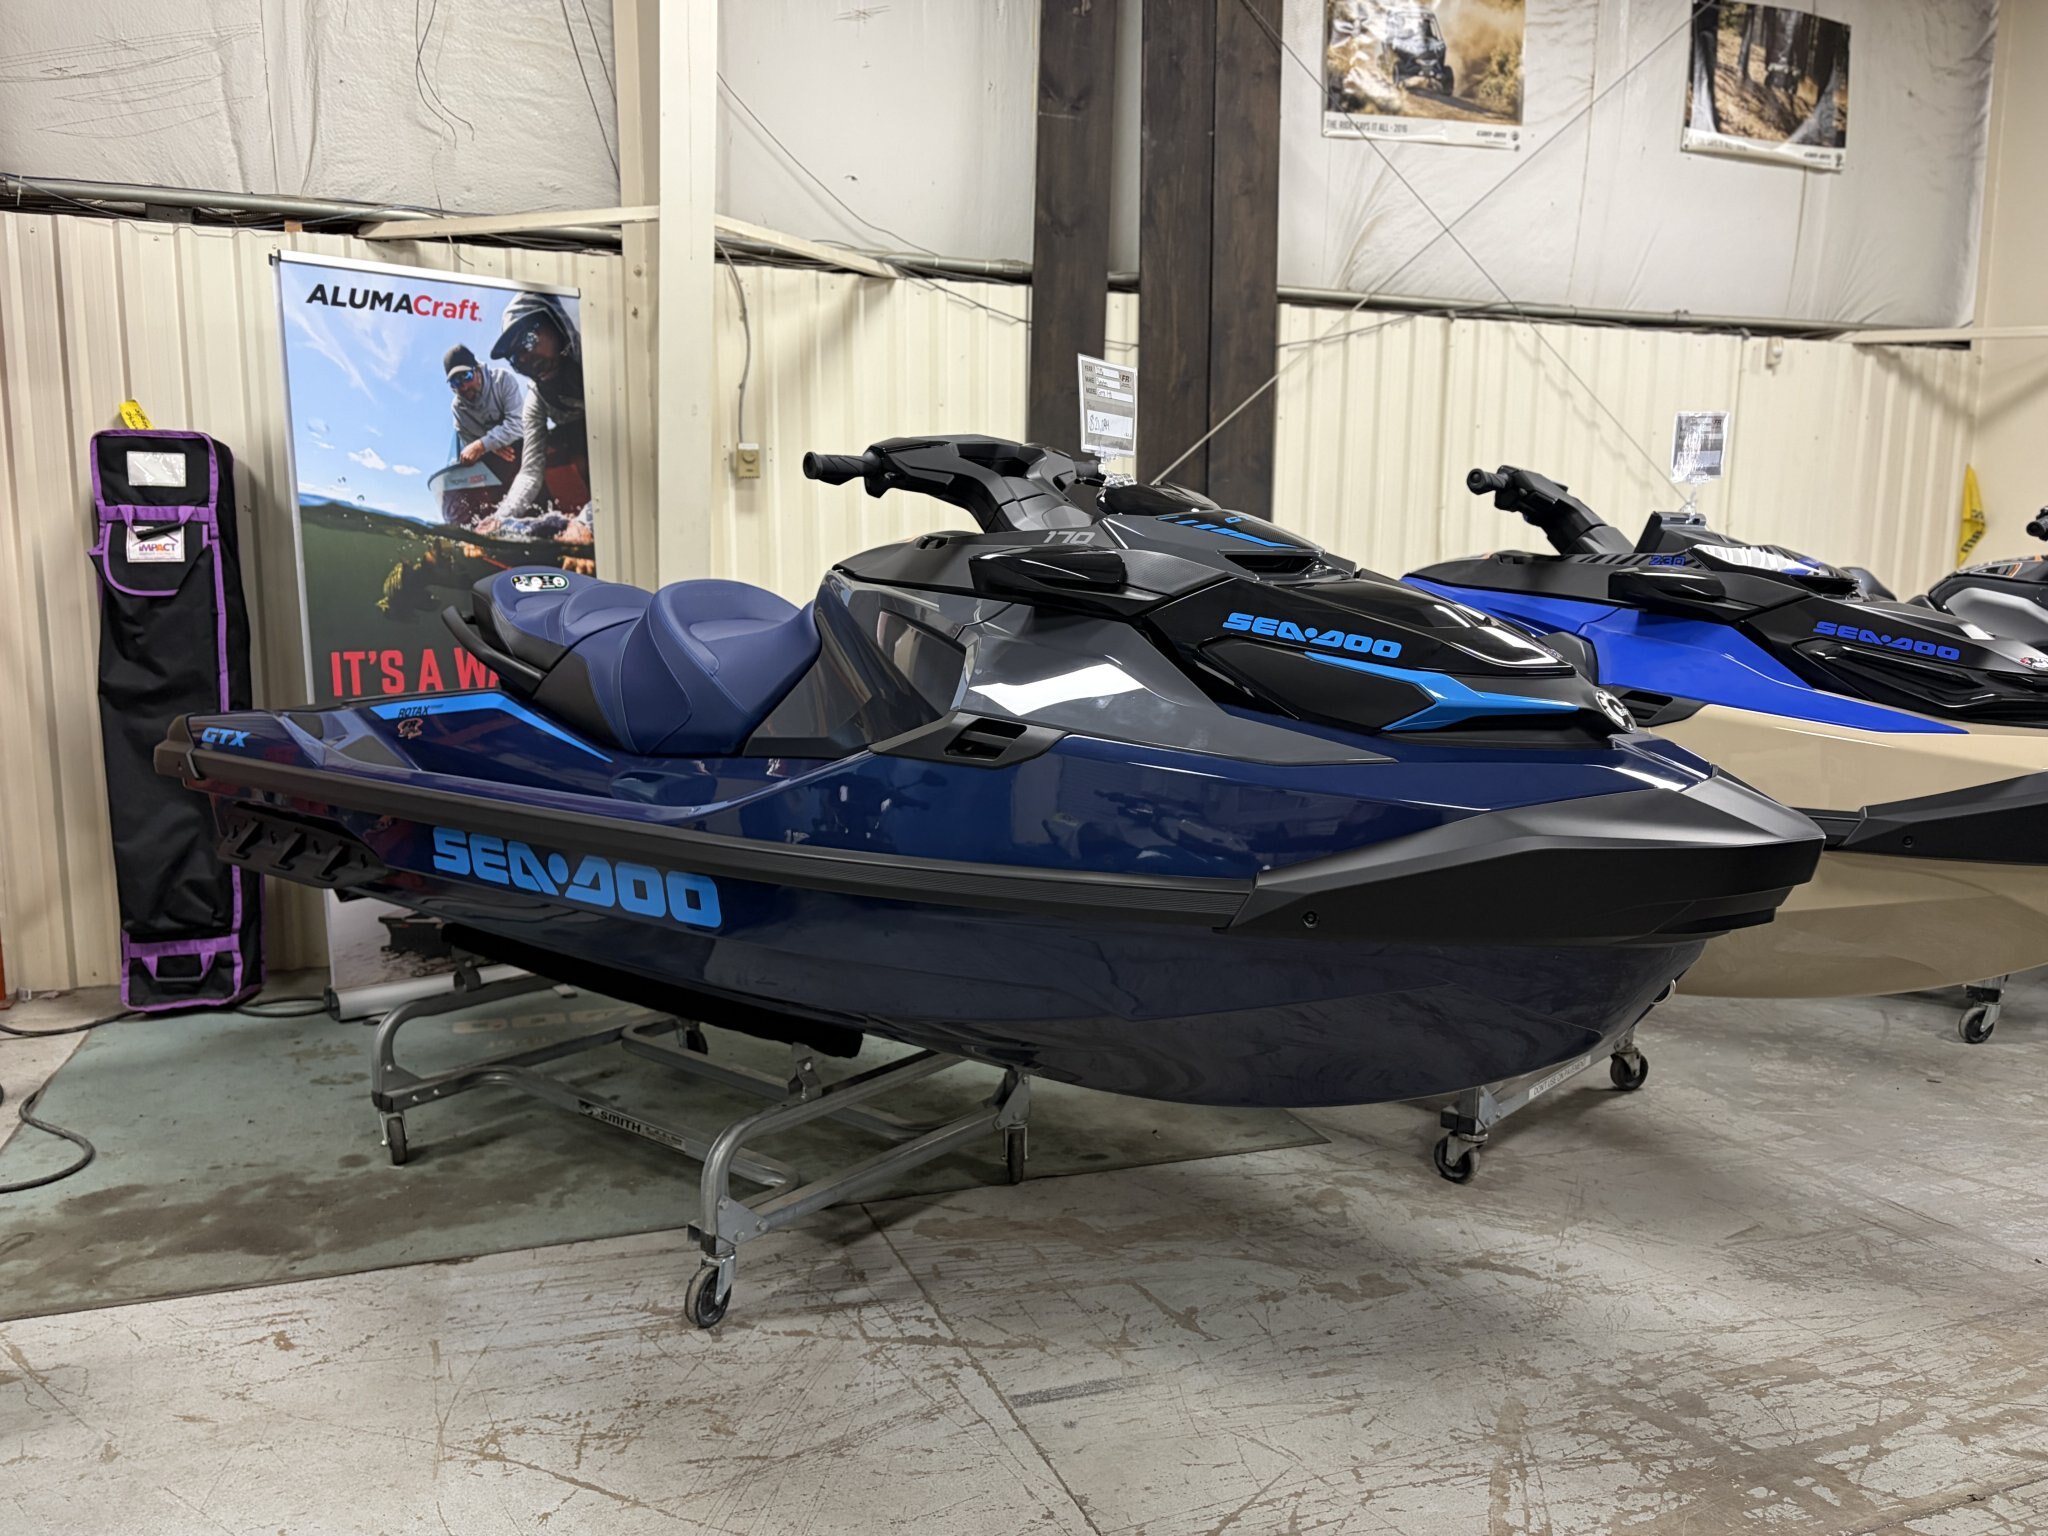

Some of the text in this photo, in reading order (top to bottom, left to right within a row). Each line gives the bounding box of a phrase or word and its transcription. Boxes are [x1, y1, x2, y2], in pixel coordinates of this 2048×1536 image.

[1327, 119, 1337, 130] THE
[1372, 121, 1378, 131] IT
[1379, 122, 1389, 132] ALL
[1043, 530, 1096, 545] 170
[1648, 554, 1687, 566] 230
[330, 650, 405, 697] IT'S
[418, 648, 444, 692] A
[398, 705, 430, 718] ROTAX
[201, 726, 251, 748] GTX
[600, 1110, 641, 1132] SMITH
